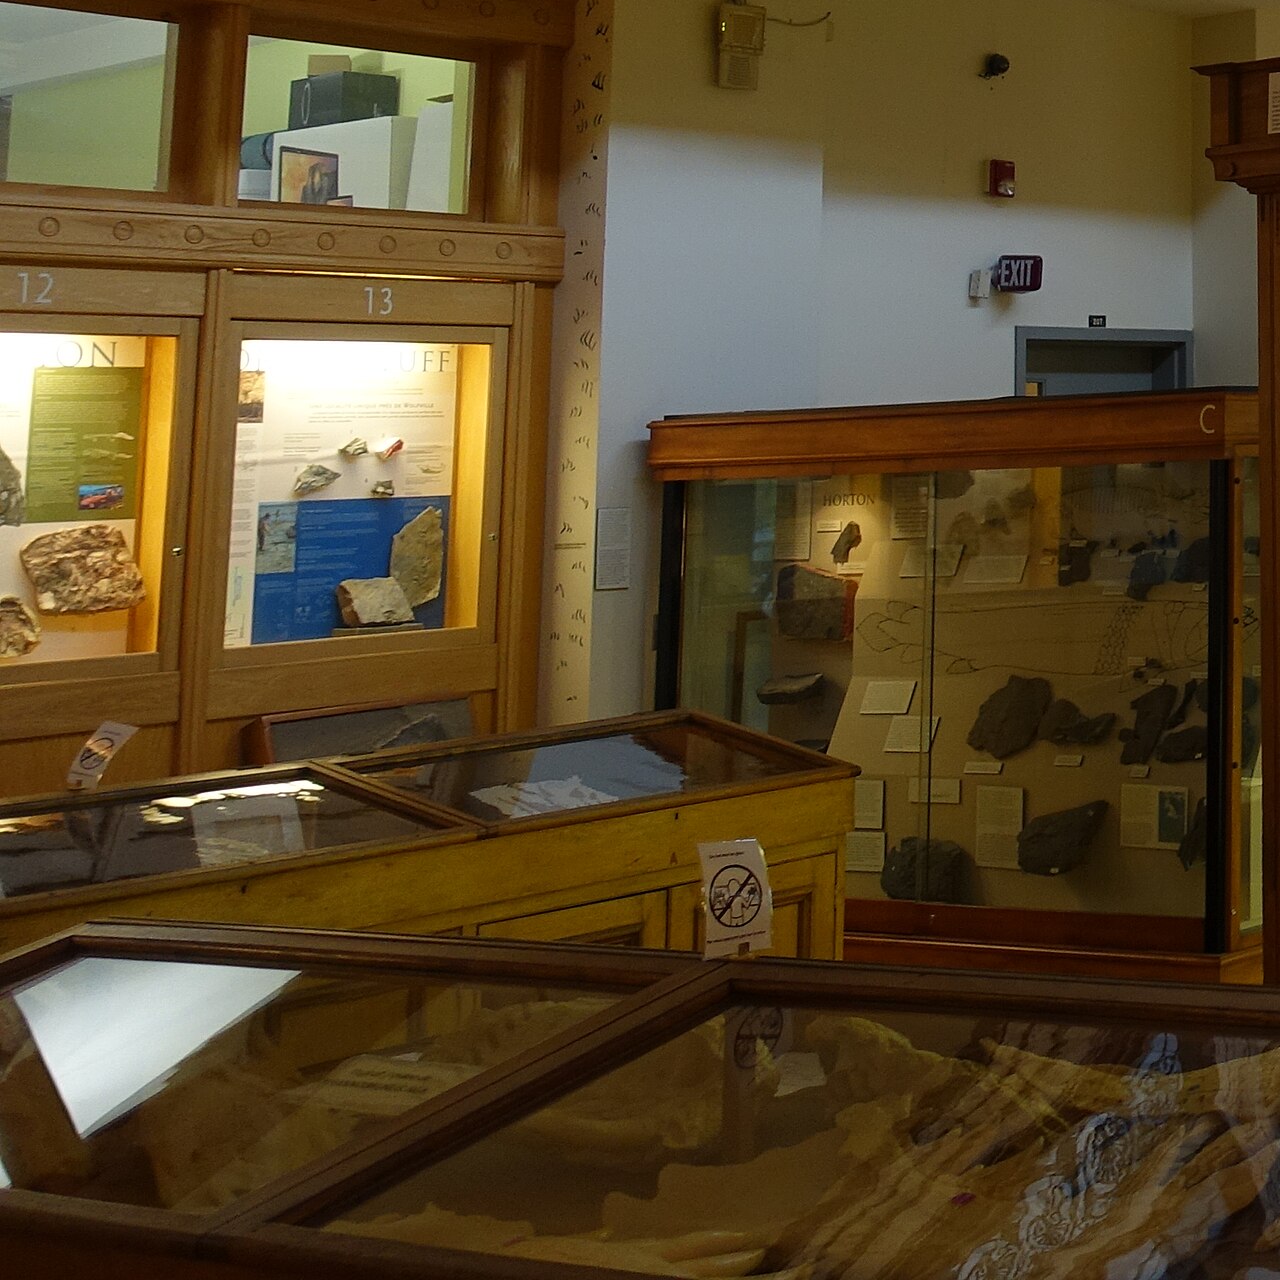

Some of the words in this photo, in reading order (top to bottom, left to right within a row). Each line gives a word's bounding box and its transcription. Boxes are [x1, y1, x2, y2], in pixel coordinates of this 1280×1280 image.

[1000, 259, 1034, 287] EXIT
[17, 272, 53, 305] 12
[363, 287, 393, 315] 13
[1199, 404, 1216, 434] C
[822, 493, 875, 507] HORTON
